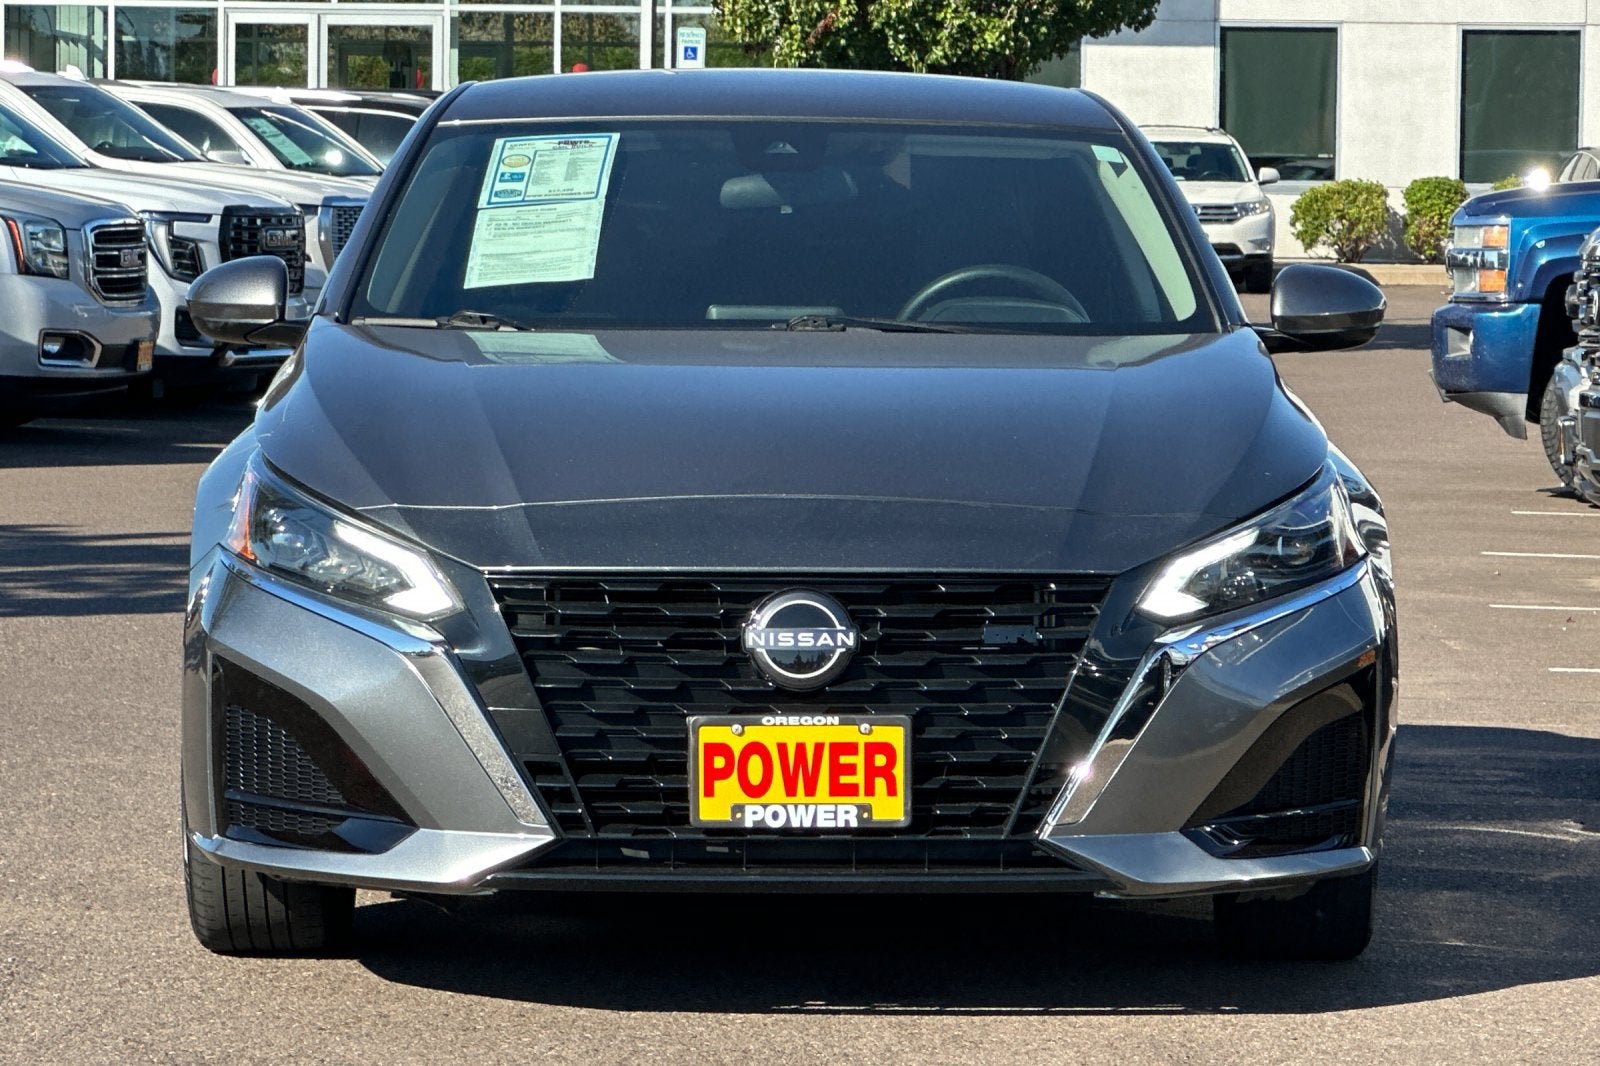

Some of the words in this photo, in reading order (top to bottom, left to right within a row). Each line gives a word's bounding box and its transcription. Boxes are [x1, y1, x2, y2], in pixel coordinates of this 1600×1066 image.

[748, 631, 855, 647] NISSAN
[761, 716, 840, 726] OREGON
[703, 741, 898, 798] POWER
[744, 804, 859, 828] POWER
